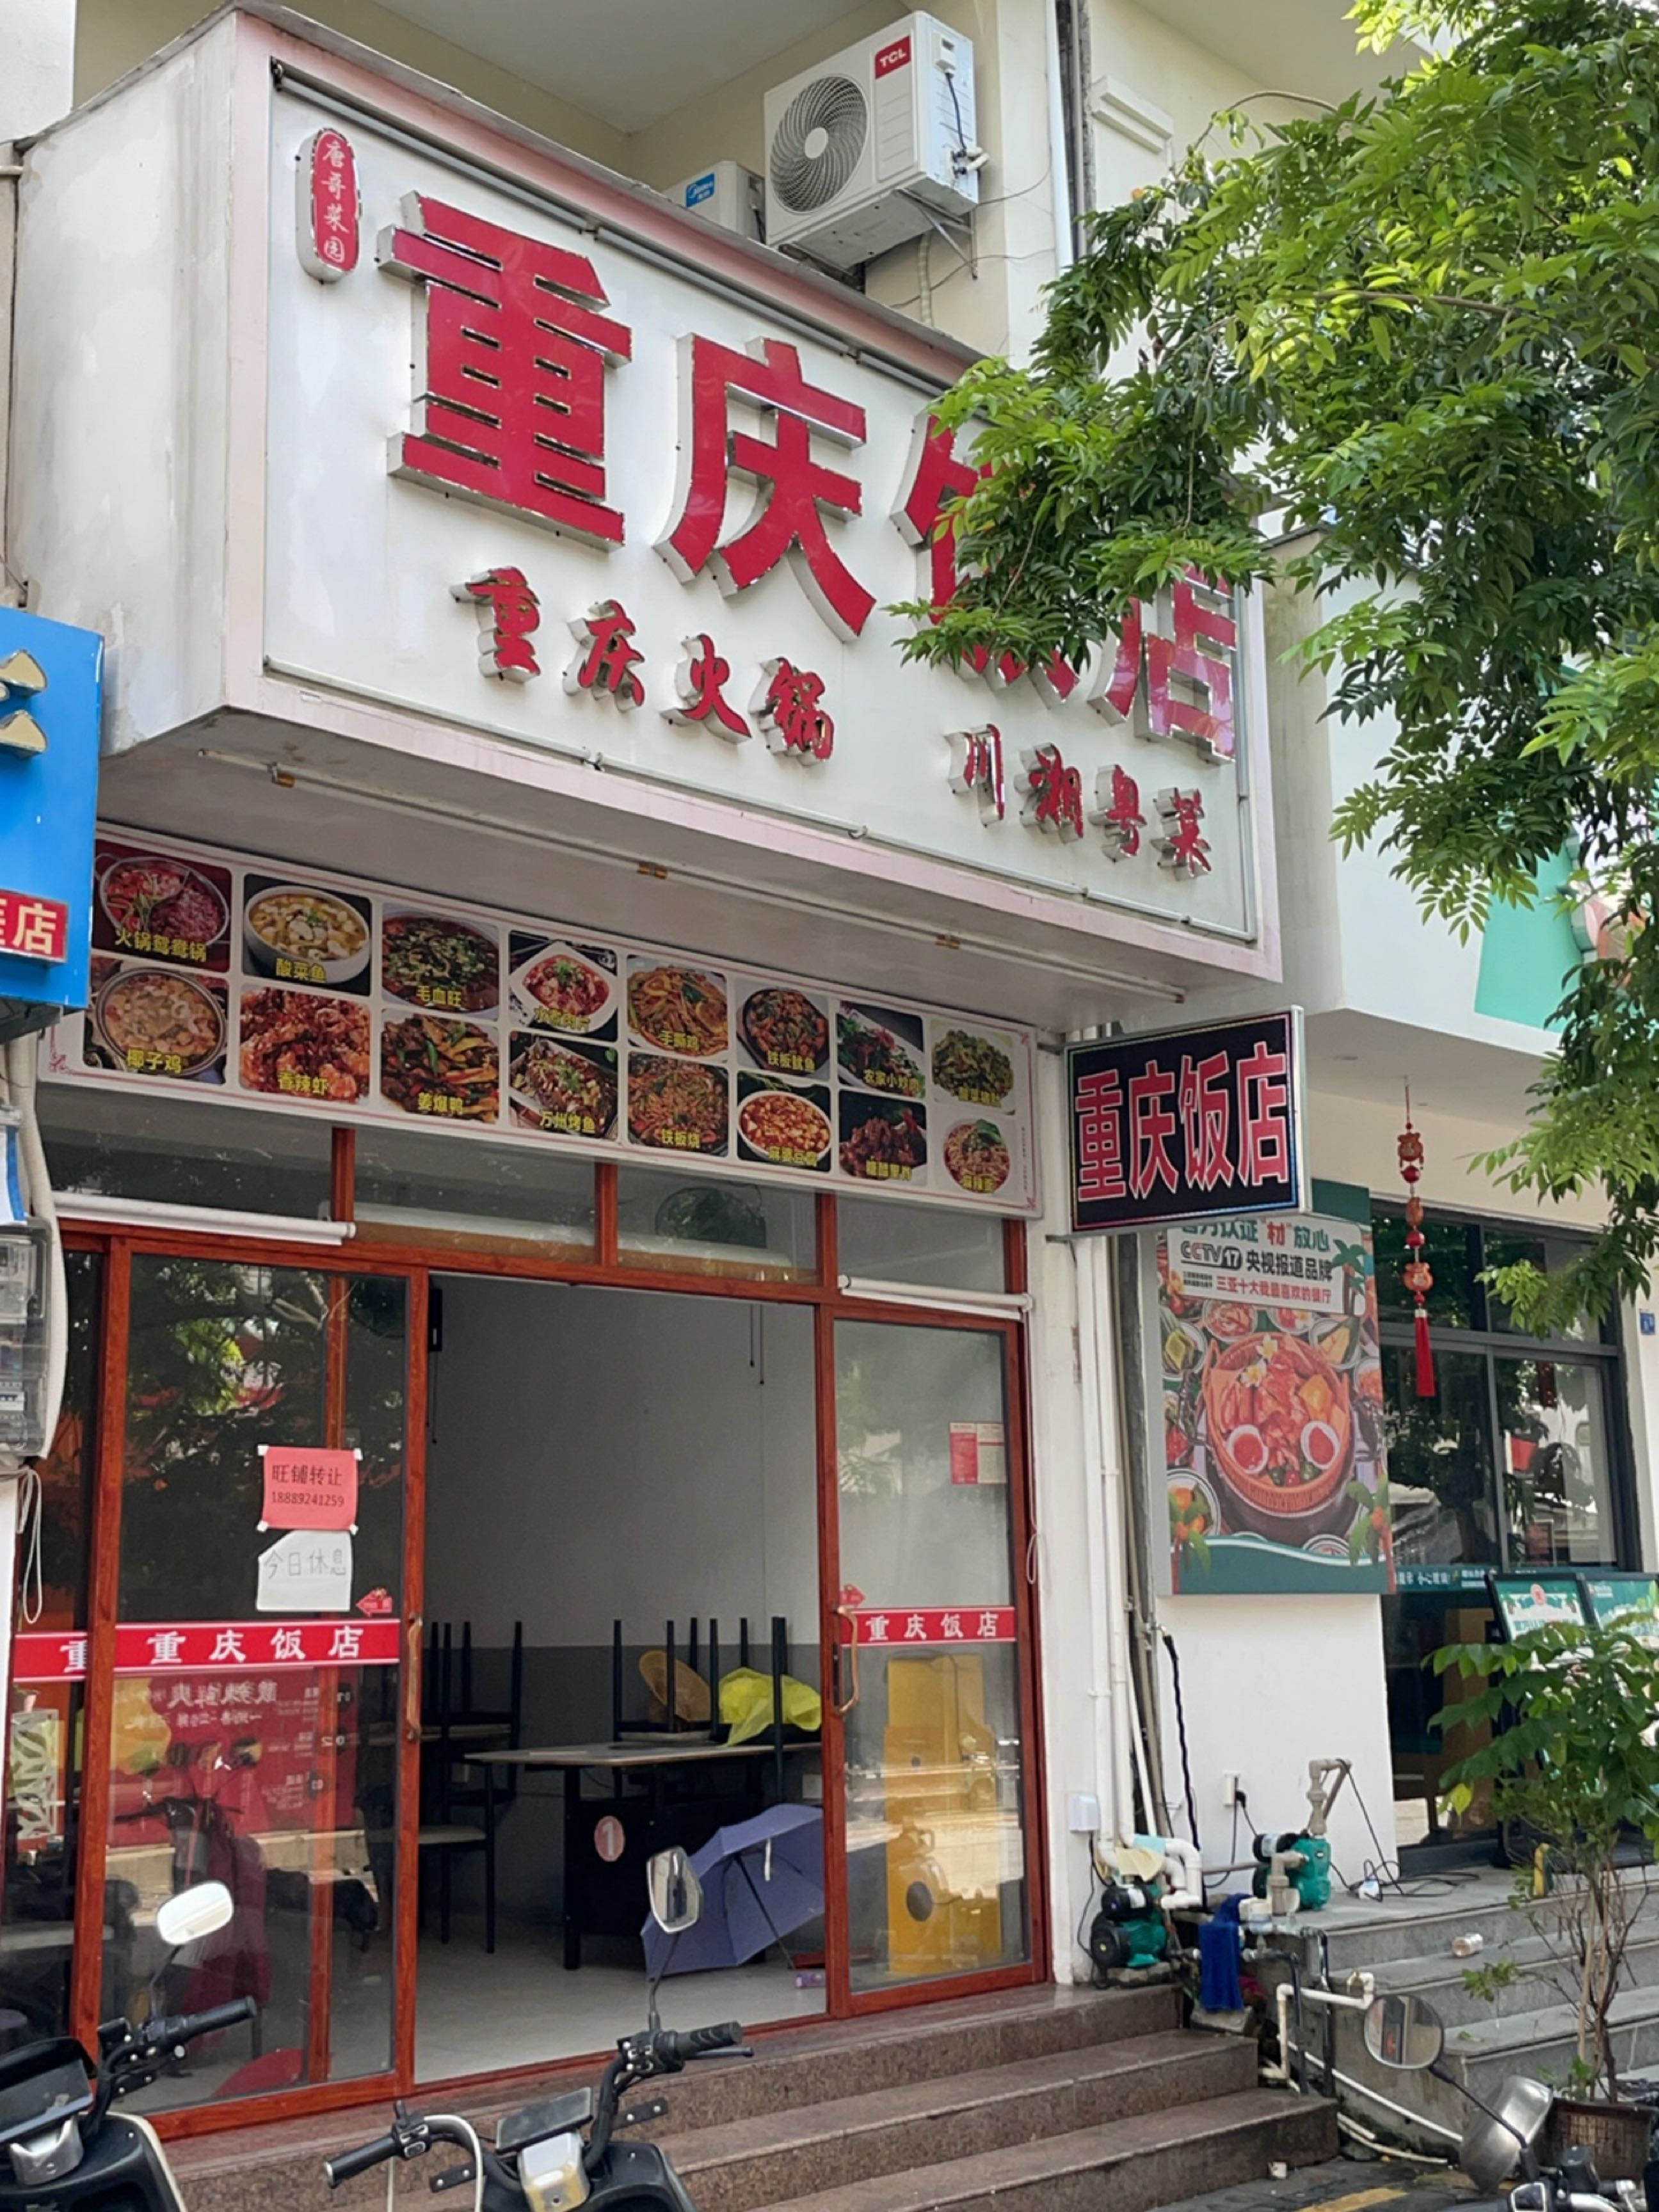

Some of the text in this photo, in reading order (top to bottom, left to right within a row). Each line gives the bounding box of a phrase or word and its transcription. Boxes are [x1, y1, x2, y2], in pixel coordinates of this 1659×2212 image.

[879, 47, 907, 68] TCL
[458, 566, 835, 763] 重庆火锅
[954, 723, 1212, 879] 川湘粤菜
[0, 899, 57, 956] 店
[115, 928, 207, 962] 火锅鸳鸯锅
[276, 958, 326, 982] 酸菜鱼
[417, 985, 462, 1007] 毛血旺
[126, 1046, 182, 1075] 椰子鸡
[1075, 1041, 1290, 1202] 重庆饭店
[1246, 1250, 1333, 1283] 央视报道品牌
[271, 1464, 342, 1487] 旺铺转让
[271, 1491, 345, 1508] 18889241259
[264, 1548, 346, 1580] 今日休息
[866, 1611, 999, 1642] 重庆饭店
[147, 1626, 364, 1665] 重庆饭店
